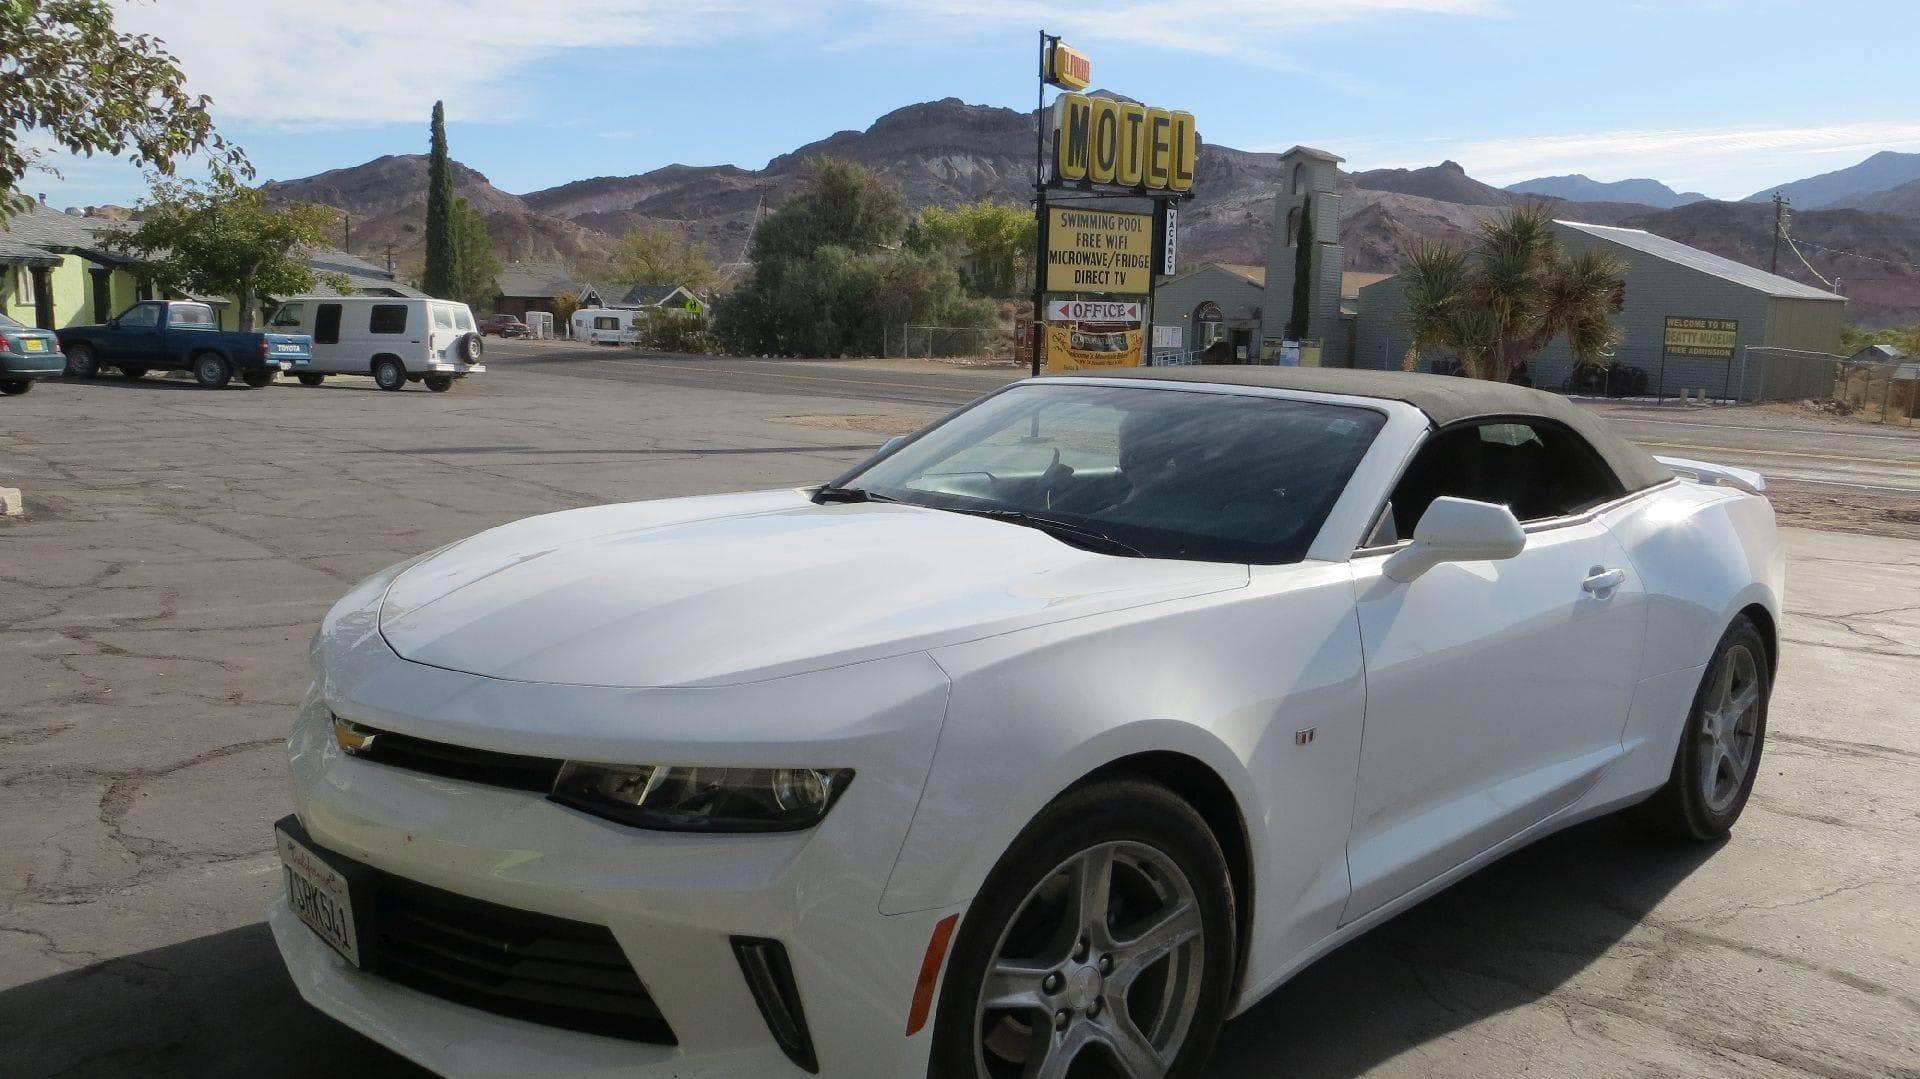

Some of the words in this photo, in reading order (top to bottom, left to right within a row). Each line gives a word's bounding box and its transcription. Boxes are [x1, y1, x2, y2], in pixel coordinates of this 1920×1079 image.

[1067, 103, 1193, 180] MOTEL
[1061, 212, 1116, 230] SWIMMING
[1118, 216, 1143, 233] POOL
[1076, 232, 1101, 249] FREE
[1106, 235, 1128, 250] WIFI
[1166, 212, 1176, 273] VACANCY
[1049, 250, 1150, 269] MICROWAVE/FRIDGE
[1074, 270, 1110, 285] DIRECT
[1115, 271, 1127, 285] TV
[1073, 303, 1126, 318] OFFICE
[1667, 319, 1707, 329] WELCOME
[1708, 320, 1718, 329] TO
[1721, 321, 1736, 330] THE
[277, 344, 301, 352] TOYOTA
[1688, 347, 1731, 356] ADMISSION
